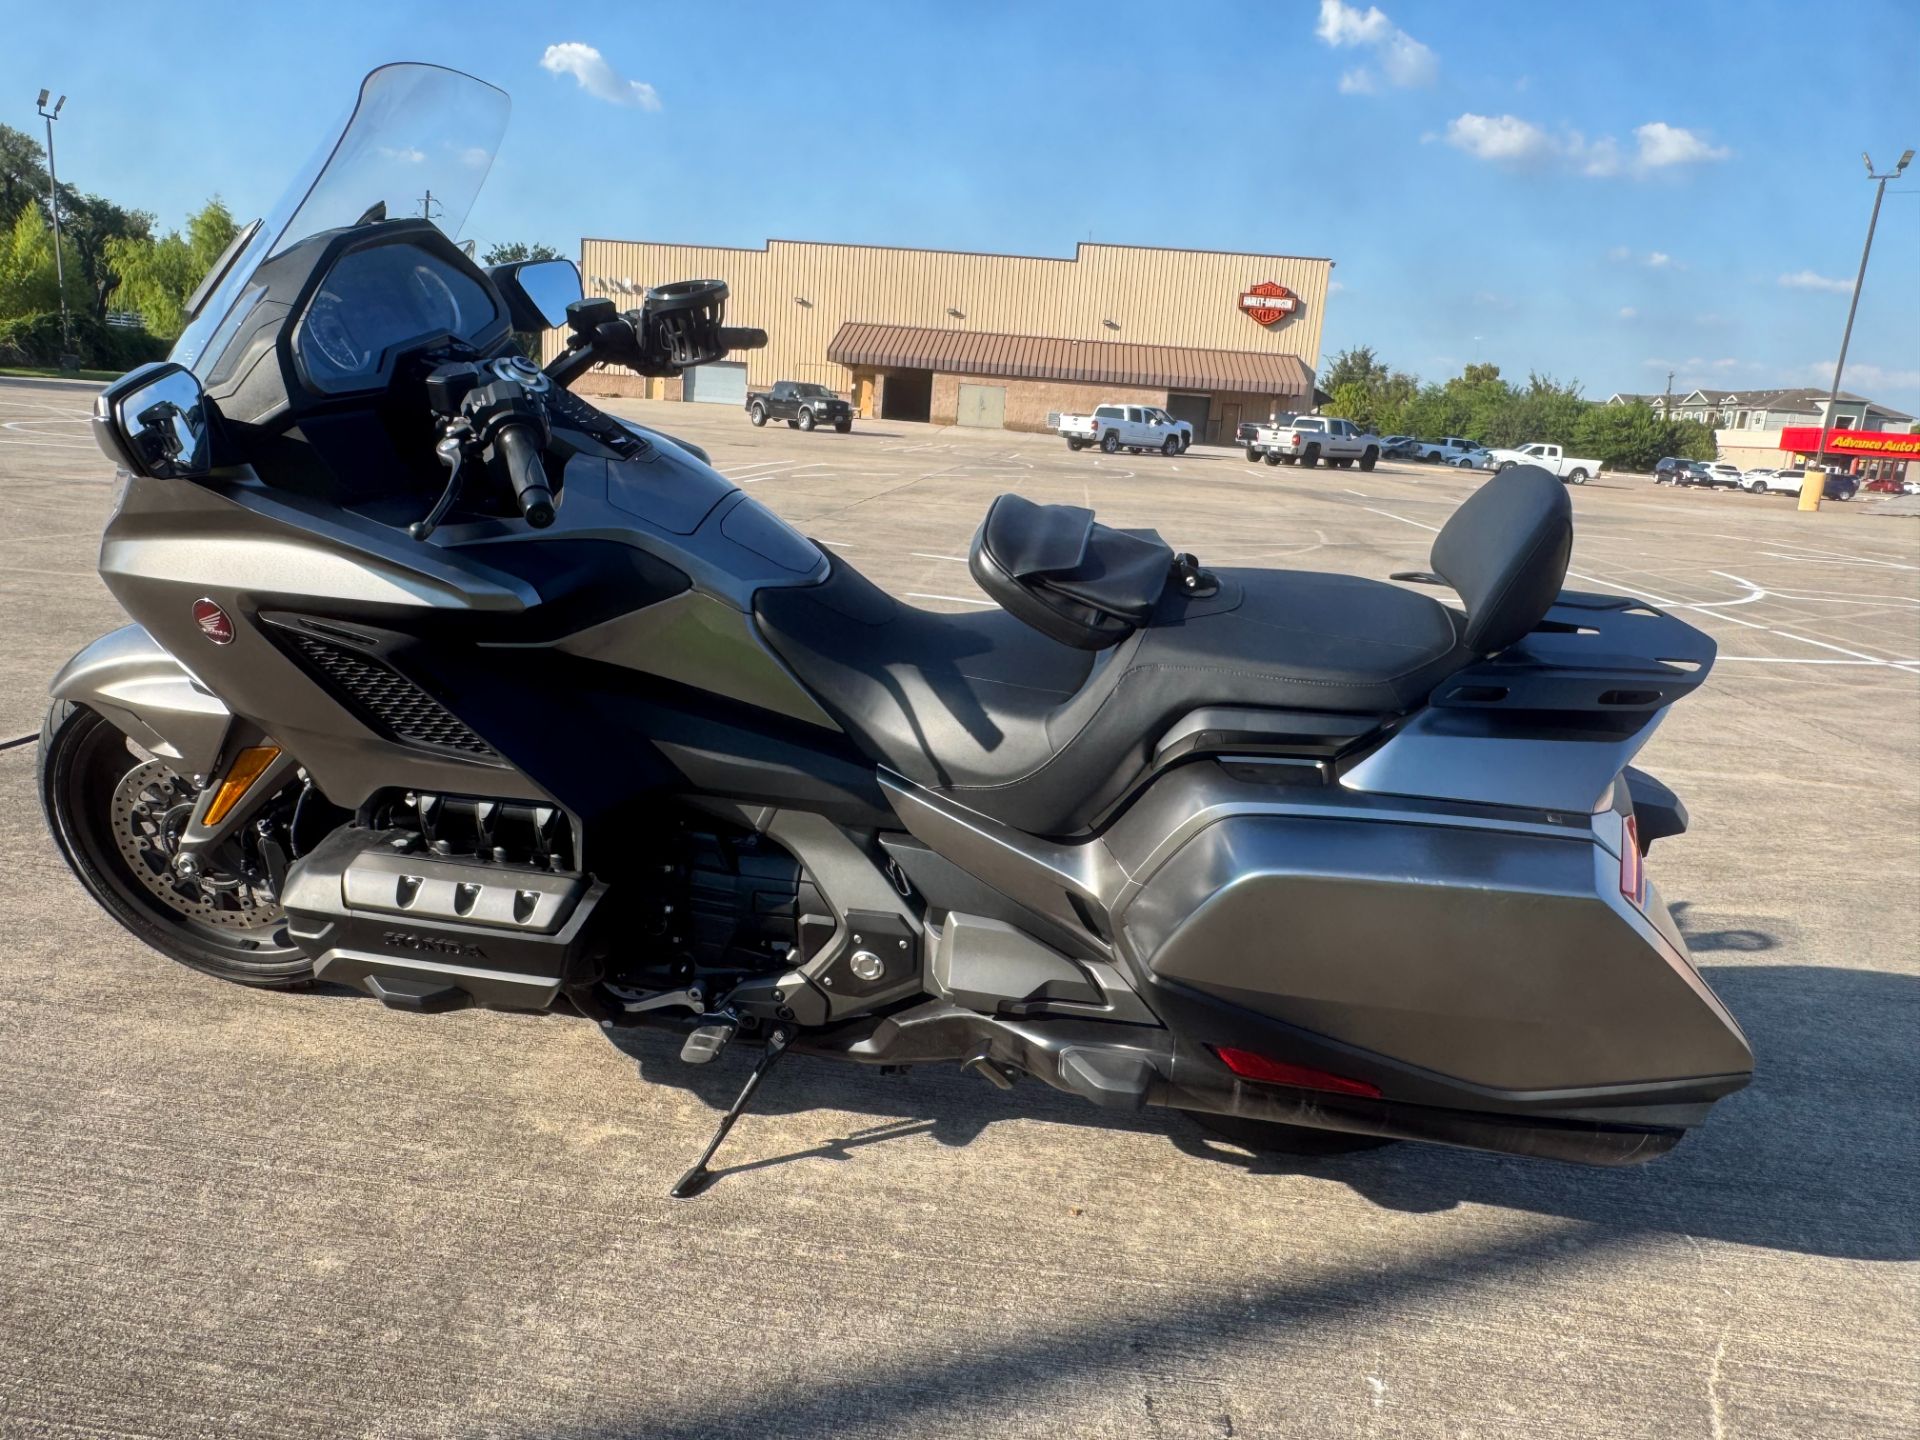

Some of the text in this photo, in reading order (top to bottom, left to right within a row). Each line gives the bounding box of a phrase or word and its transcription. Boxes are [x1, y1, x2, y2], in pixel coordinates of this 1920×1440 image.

[1831, 436, 1882, 449] Advance
[1882, 440, 1913, 452] Auto
[383, 932, 488, 959] HONDA
